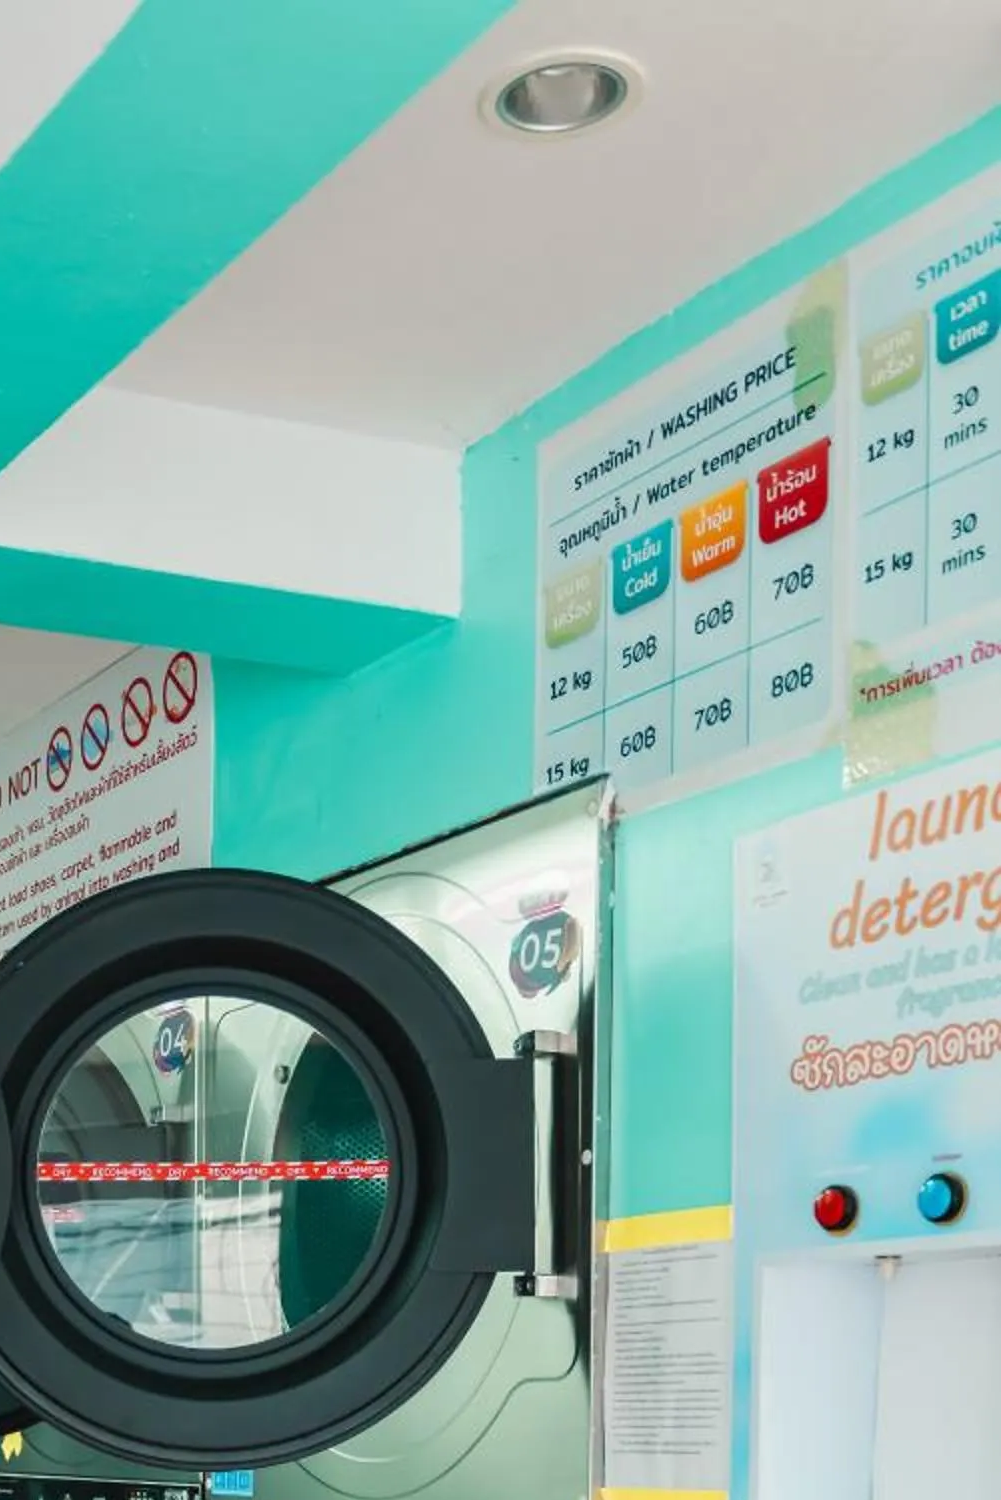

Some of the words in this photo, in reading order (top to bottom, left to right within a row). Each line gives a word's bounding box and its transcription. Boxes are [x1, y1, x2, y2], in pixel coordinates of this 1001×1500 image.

[949, 319, 989, 352] time
[660, 381, 739, 441] WASHING
[743, 346, 798, 393] PRICE
[951, 384, 981, 415] 30
[866, 437, 887, 463] 12
[893, 428, 916, 450] kg
[943, 416, 989, 451] mins
[646, 467, 696, 506] Water
[701, 403, 817, 477] temperature
[765, 463, 818, 502] น้ำร้อน
[773, 499, 808, 529] Hot
[950, 511, 979, 541] 30
[691, 534, 737, 568] Warm
[863, 559, 886, 585] 15
[891, 550, 914, 572] kg
[941, 544, 987, 575] mins
[623, 567, 659, 598] Cold
[550, 676, 568, 700] 12
[572, 669, 593, 696] kg
[8, 757, 41, 805] NOT
[545, 761, 564, 786] 15
[570, 755, 590, 778] kg
[154, 807, 178, 836] and
[158, 837, 181, 863] and
[520, 927, 562, 973] 05
[865, 946, 913, 990] and
[159, 1022, 189, 1058] 04
